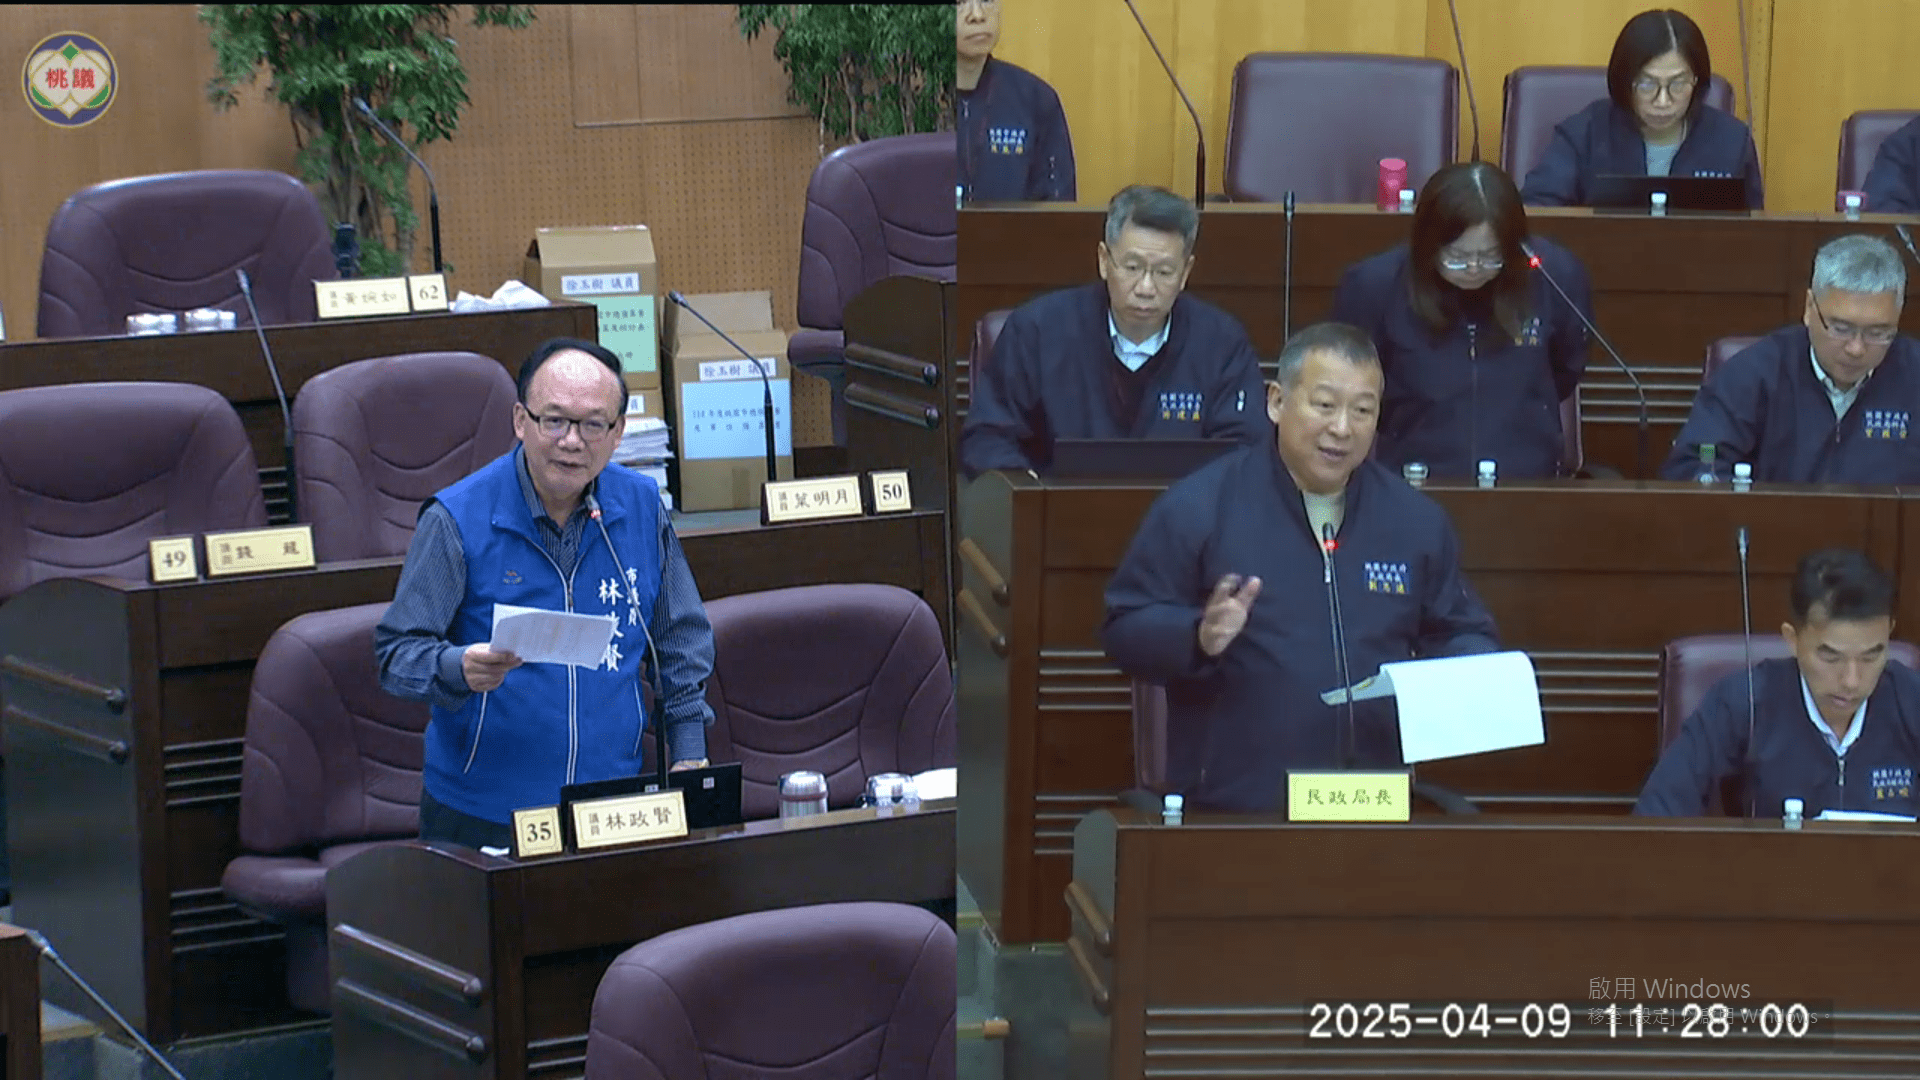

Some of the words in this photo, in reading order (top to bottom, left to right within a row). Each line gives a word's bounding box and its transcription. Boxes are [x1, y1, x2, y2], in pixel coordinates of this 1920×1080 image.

[419, 285, 438, 300] 62
[795, 489, 849, 509] 葉明月
[882, 483, 903, 501] 50
[162, 550, 187, 568] 49
[1307, 788, 1393, 806] 民政局長
[606, 806, 672, 831] 林政賢
[526, 821, 553, 844] 35
